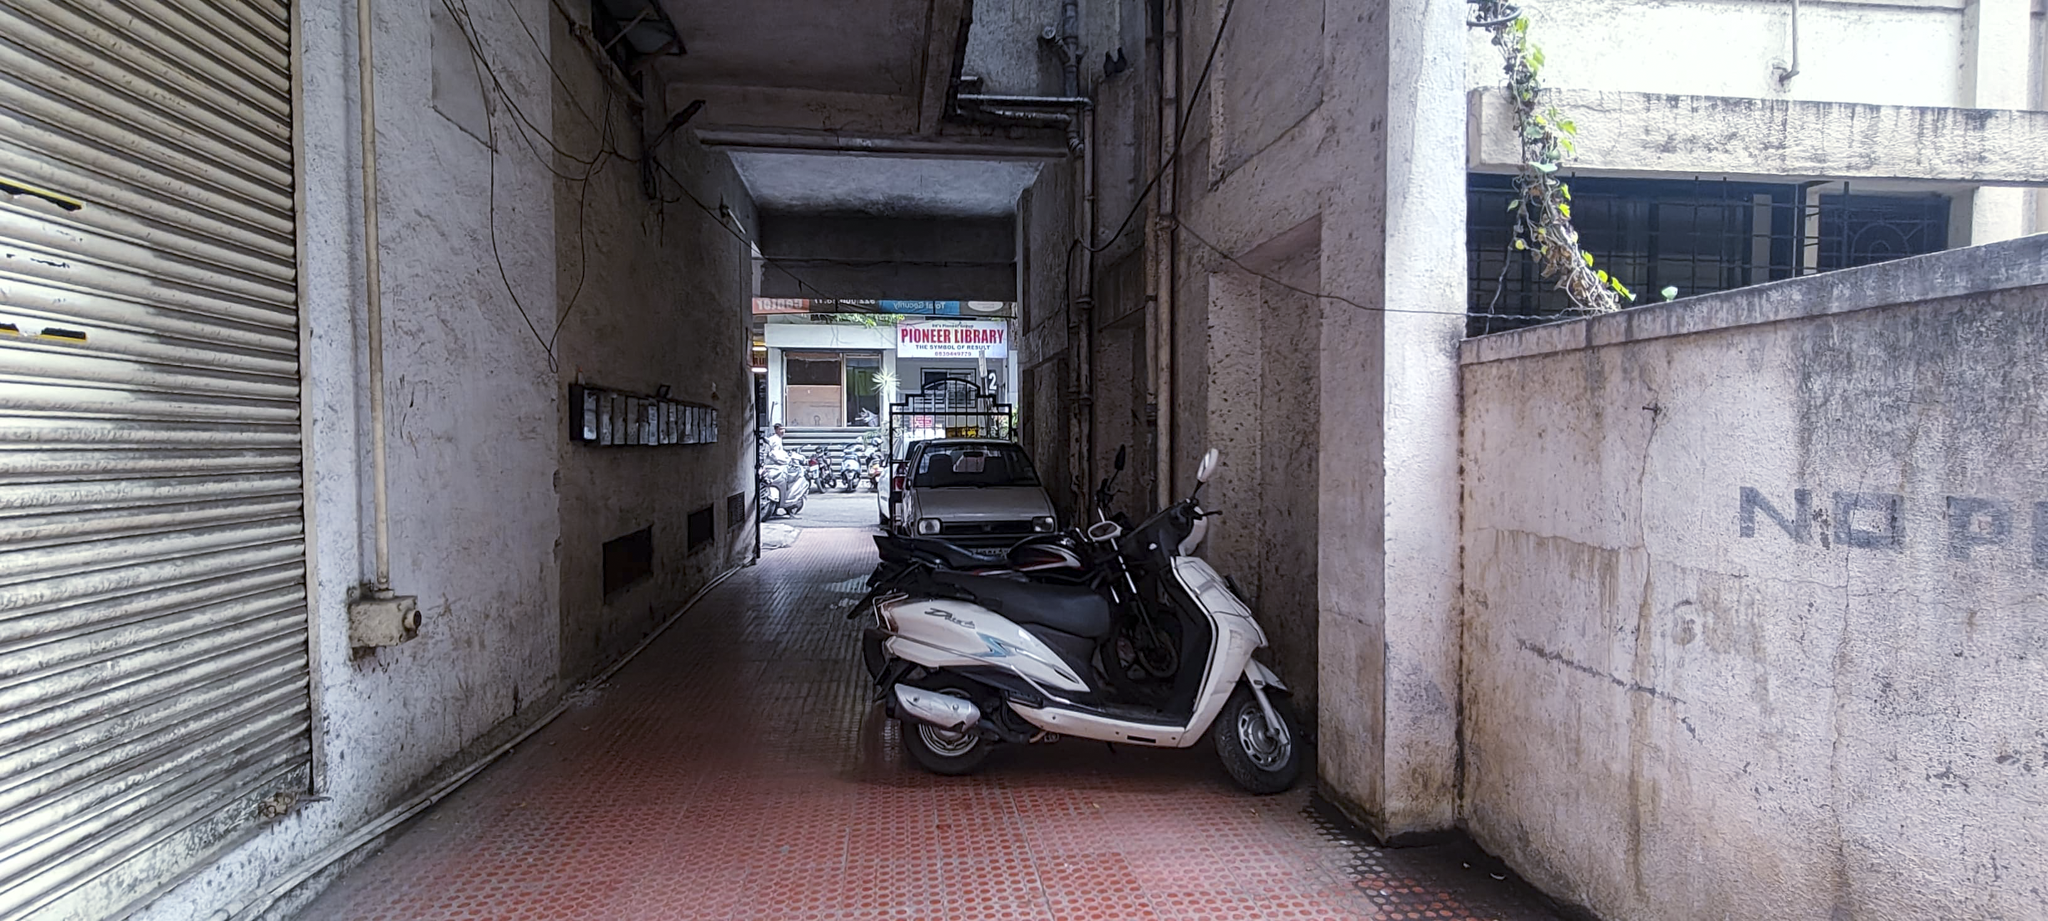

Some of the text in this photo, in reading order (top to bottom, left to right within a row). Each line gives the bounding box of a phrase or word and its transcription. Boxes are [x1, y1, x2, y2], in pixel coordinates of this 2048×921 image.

[901, 328, 1004, 344] PIONEER LIBRARY
[1739, 486, 1906, 552] NO
